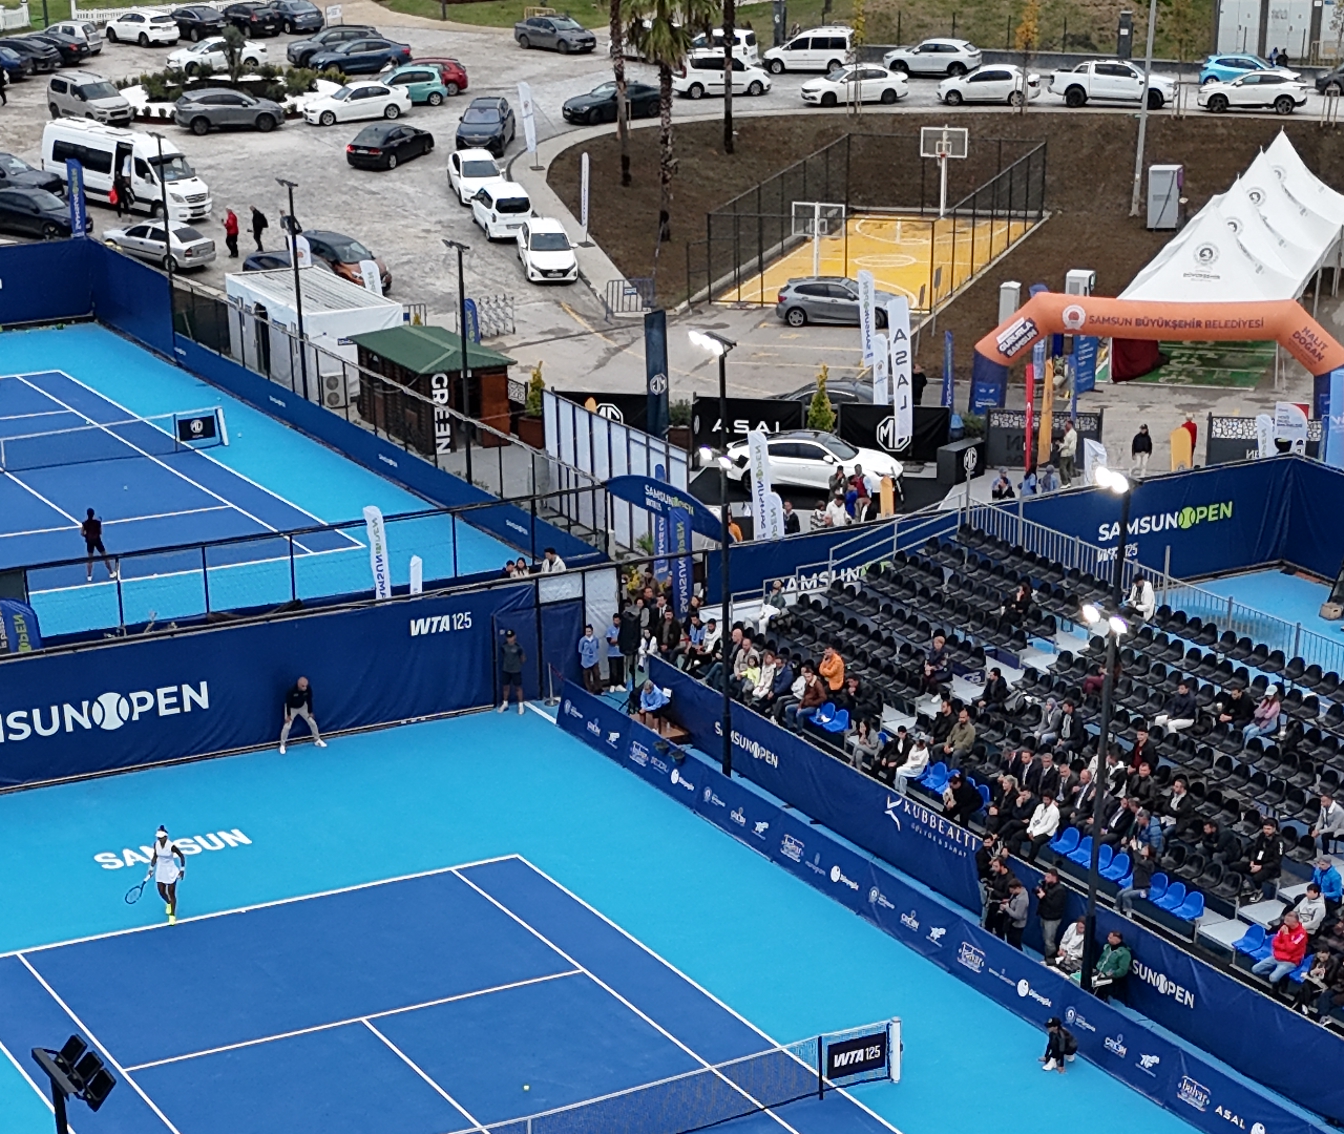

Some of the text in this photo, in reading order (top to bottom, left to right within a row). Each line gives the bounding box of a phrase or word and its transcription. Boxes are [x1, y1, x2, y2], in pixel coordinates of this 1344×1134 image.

[1088, 315, 1133, 327] SAMSUN
[410, 611, 472, 636] WTA 125
[714, 721, 779, 768] SMSUNOPEN
[834, 1044, 881, 1070] WTA 125
[1214, 1104, 1246, 1130] ASAL
